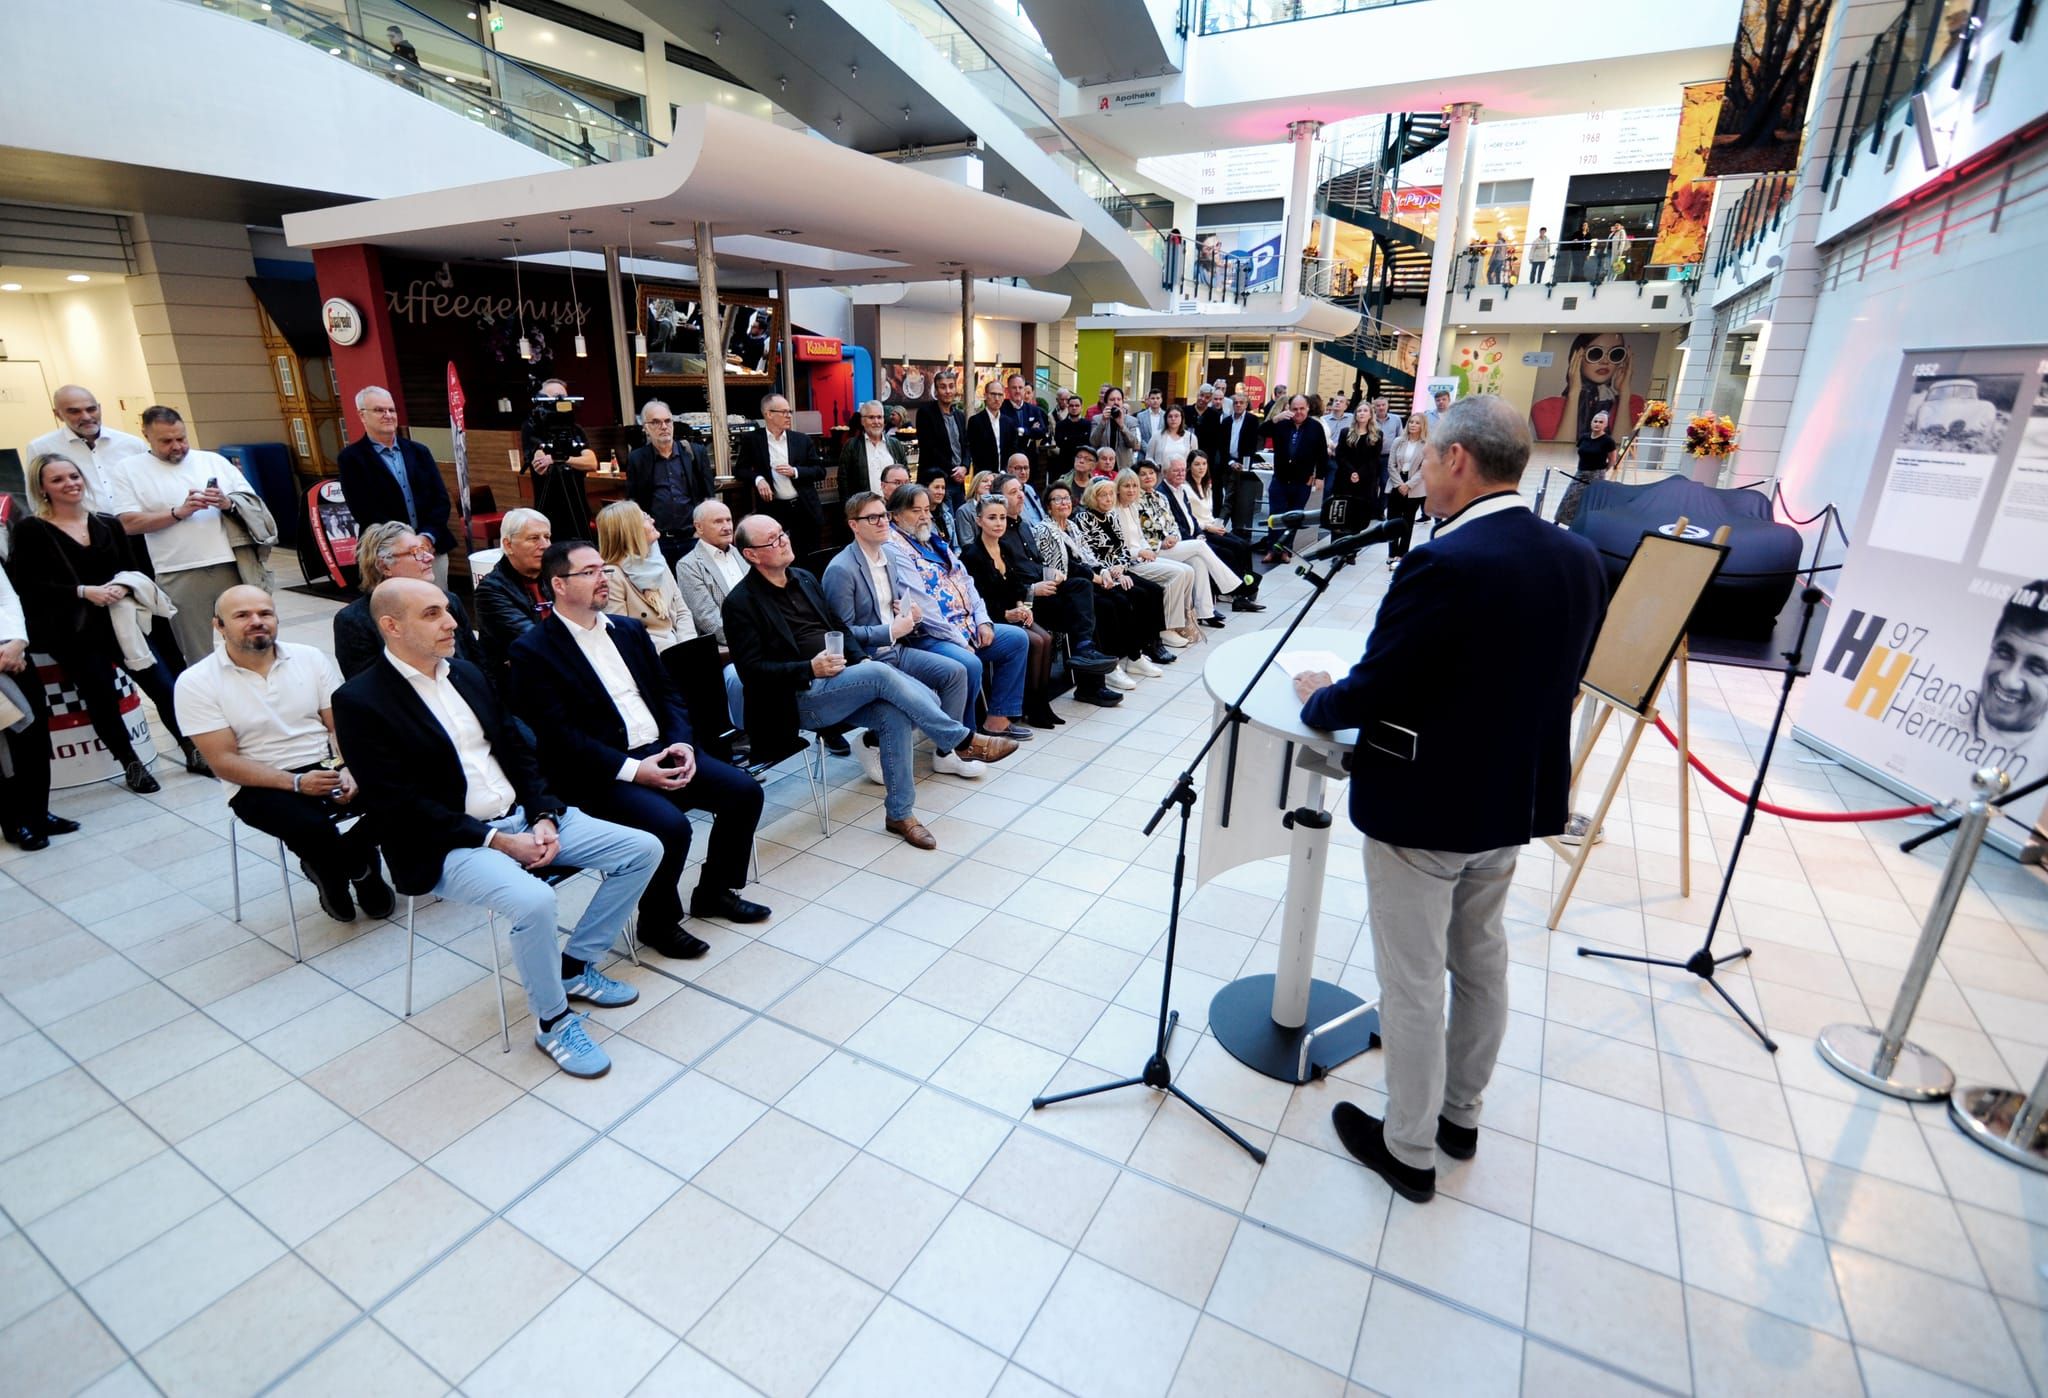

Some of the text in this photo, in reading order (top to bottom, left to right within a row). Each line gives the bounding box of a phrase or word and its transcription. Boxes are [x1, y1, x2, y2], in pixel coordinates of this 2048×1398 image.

[1115, 91, 1156, 102] Apotheke
[1582, 132, 1600, 143] 1968
[1579, 154, 1598, 165] 1970
[1201, 167, 1216, 177] 1955
[1201, 186, 1214, 196] 1956
[1249, 245, 1275, 281] P
[384, 279, 592, 326] affeegenuss
[2012, 587, 2039, 607] IM
[1888, 622, 1929, 654] 97
[1899, 657, 1978, 716] Hans
[1881, 691, 2029, 782] Herrmann
